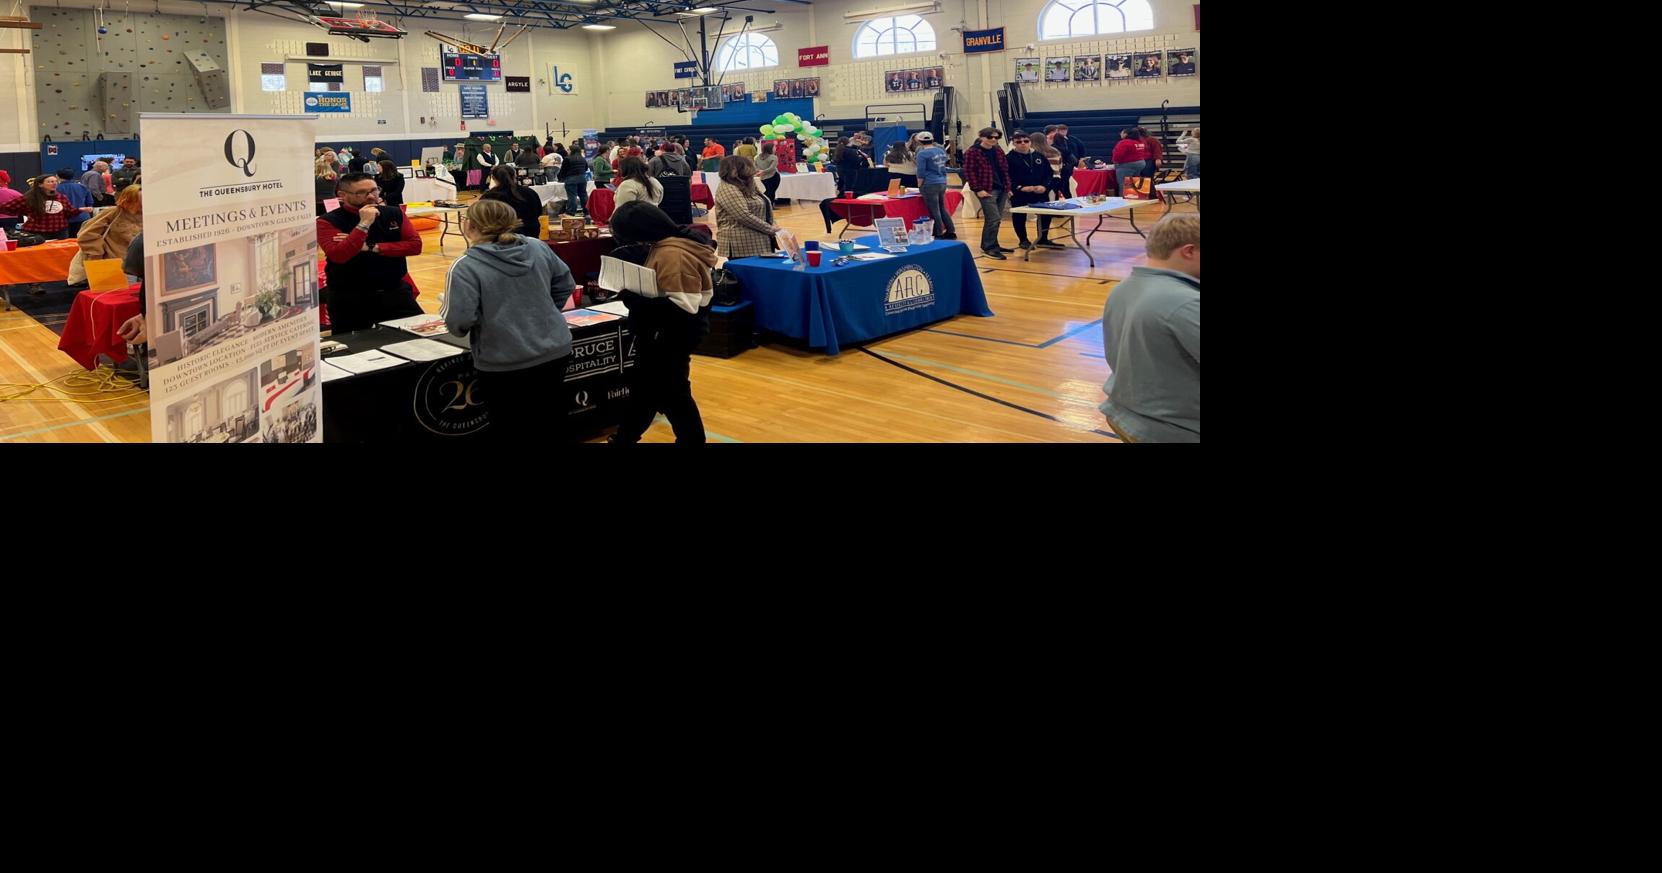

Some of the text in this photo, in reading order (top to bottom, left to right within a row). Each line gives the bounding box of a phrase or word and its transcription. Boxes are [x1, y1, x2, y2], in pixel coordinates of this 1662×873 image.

[966, 34, 1001, 46] GRANVILLE
[224, 129, 256, 177] Q
[200, 182, 284, 198] THE QUEENSBURY HOTEL
[166, 200, 306, 234] MEETINGS & EVENTS
[156, 231, 212, 247] ESTABLISHED
[236, 219, 276, 232] DOWNTOWN
[276, 216, 295, 225] GLENS
[895, 274, 923, 300] ARC
[163, 362, 208, 385] DOWNTOWN
[209, 348, 246, 366] LOCATION
[264, 329, 289, 343] SERVICE
[177, 353, 211, 372] HISTORIC
[212, 338, 247, 357] ELEGANCE
[571, 340, 615, 359] RUCE
[179, 373, 202, 388] GUEST
[204, 362, 229, 376] ROOMS
[566, 355, 617, 374] SPITALITY
[575, 390, 589, 406] Q
